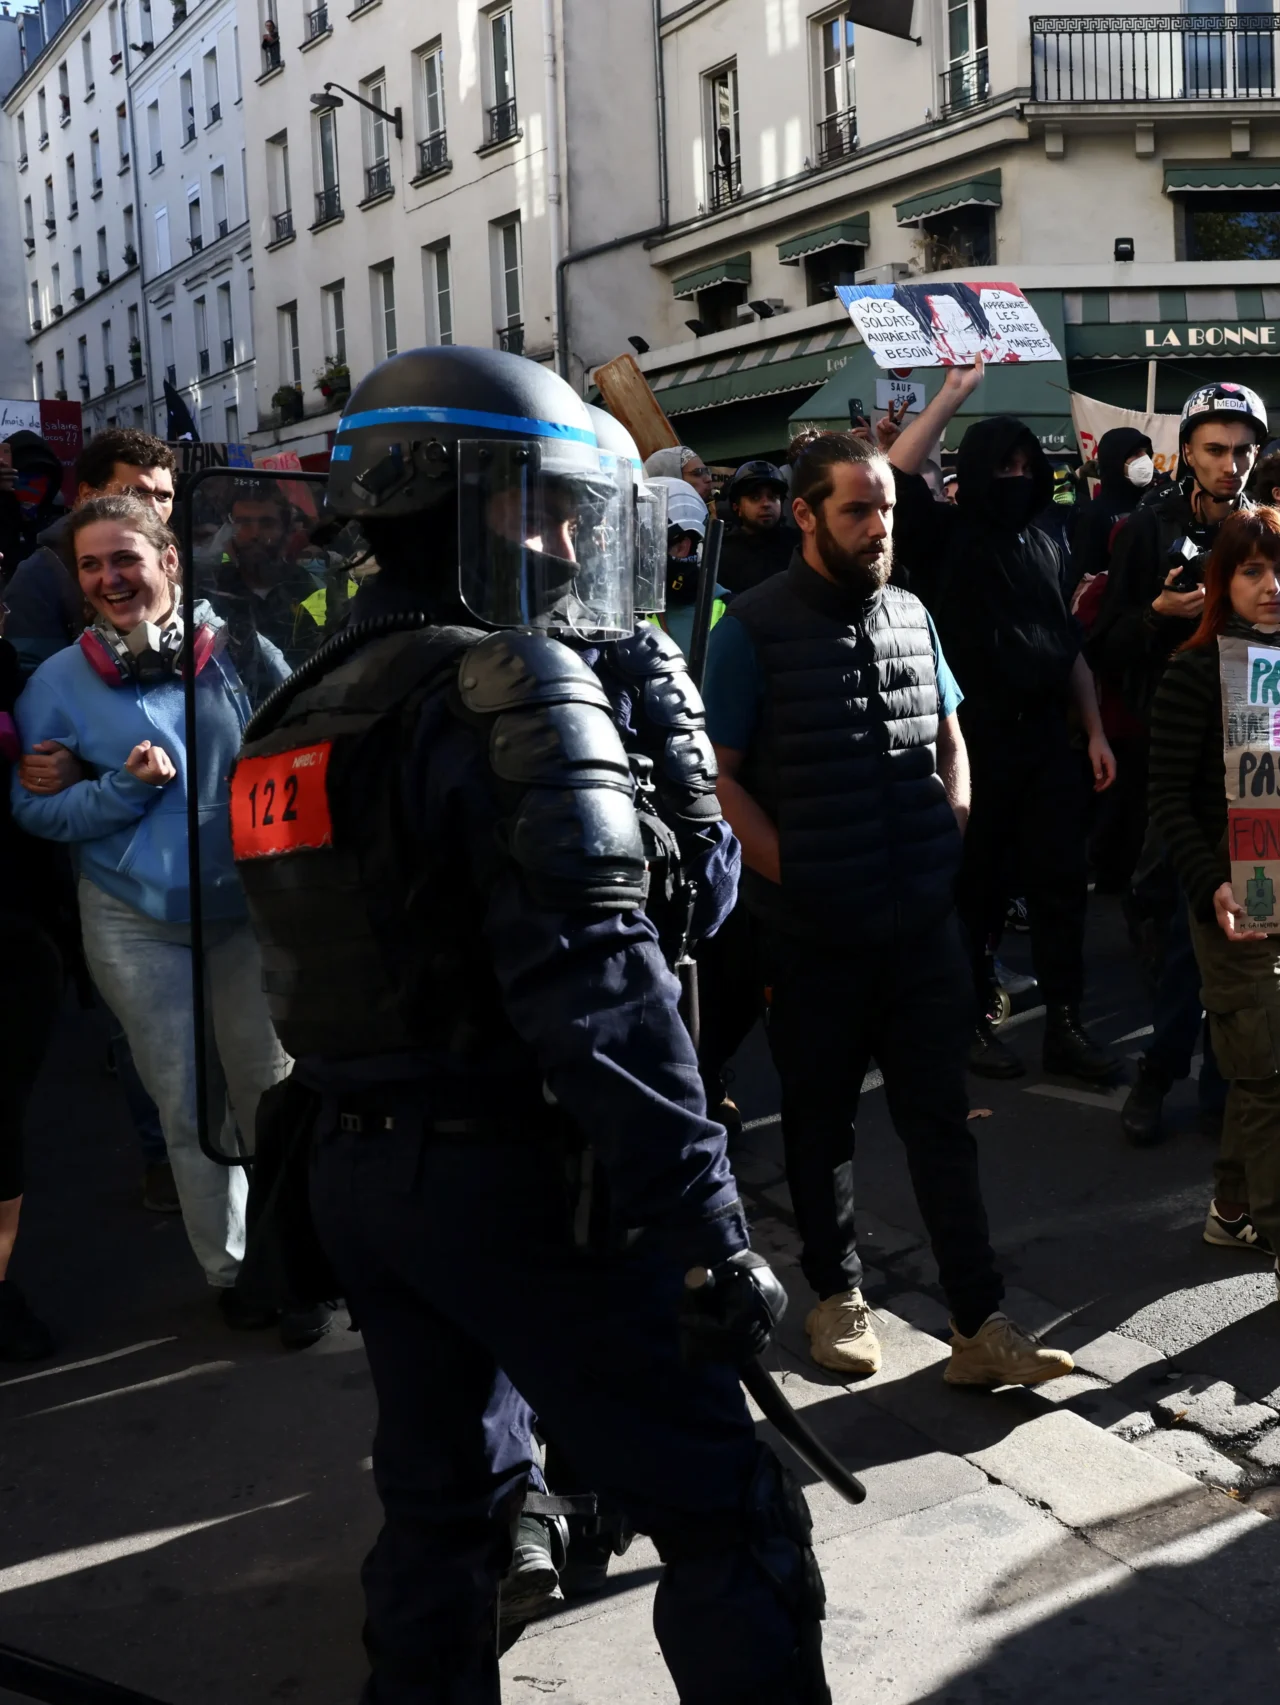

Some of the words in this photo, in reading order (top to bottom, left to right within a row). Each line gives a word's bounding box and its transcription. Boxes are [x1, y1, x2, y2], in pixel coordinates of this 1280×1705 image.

[858, 302, 895, 314] VOS
[860, 315, 915, 328] SOLDATS
[996, 311, 1020, 321] LES
[998, 323, 1039, 333] BONNES
[1145, 329, 1182, 347] LA
[1188, 327, 1276, 346] BONNE
[827, 356, 853, 373] Rest
[890, 382, 912, 392] SAUF
[1216, 400, 1245, 408] MEDIA
[249, 774, 298, 829] 122
